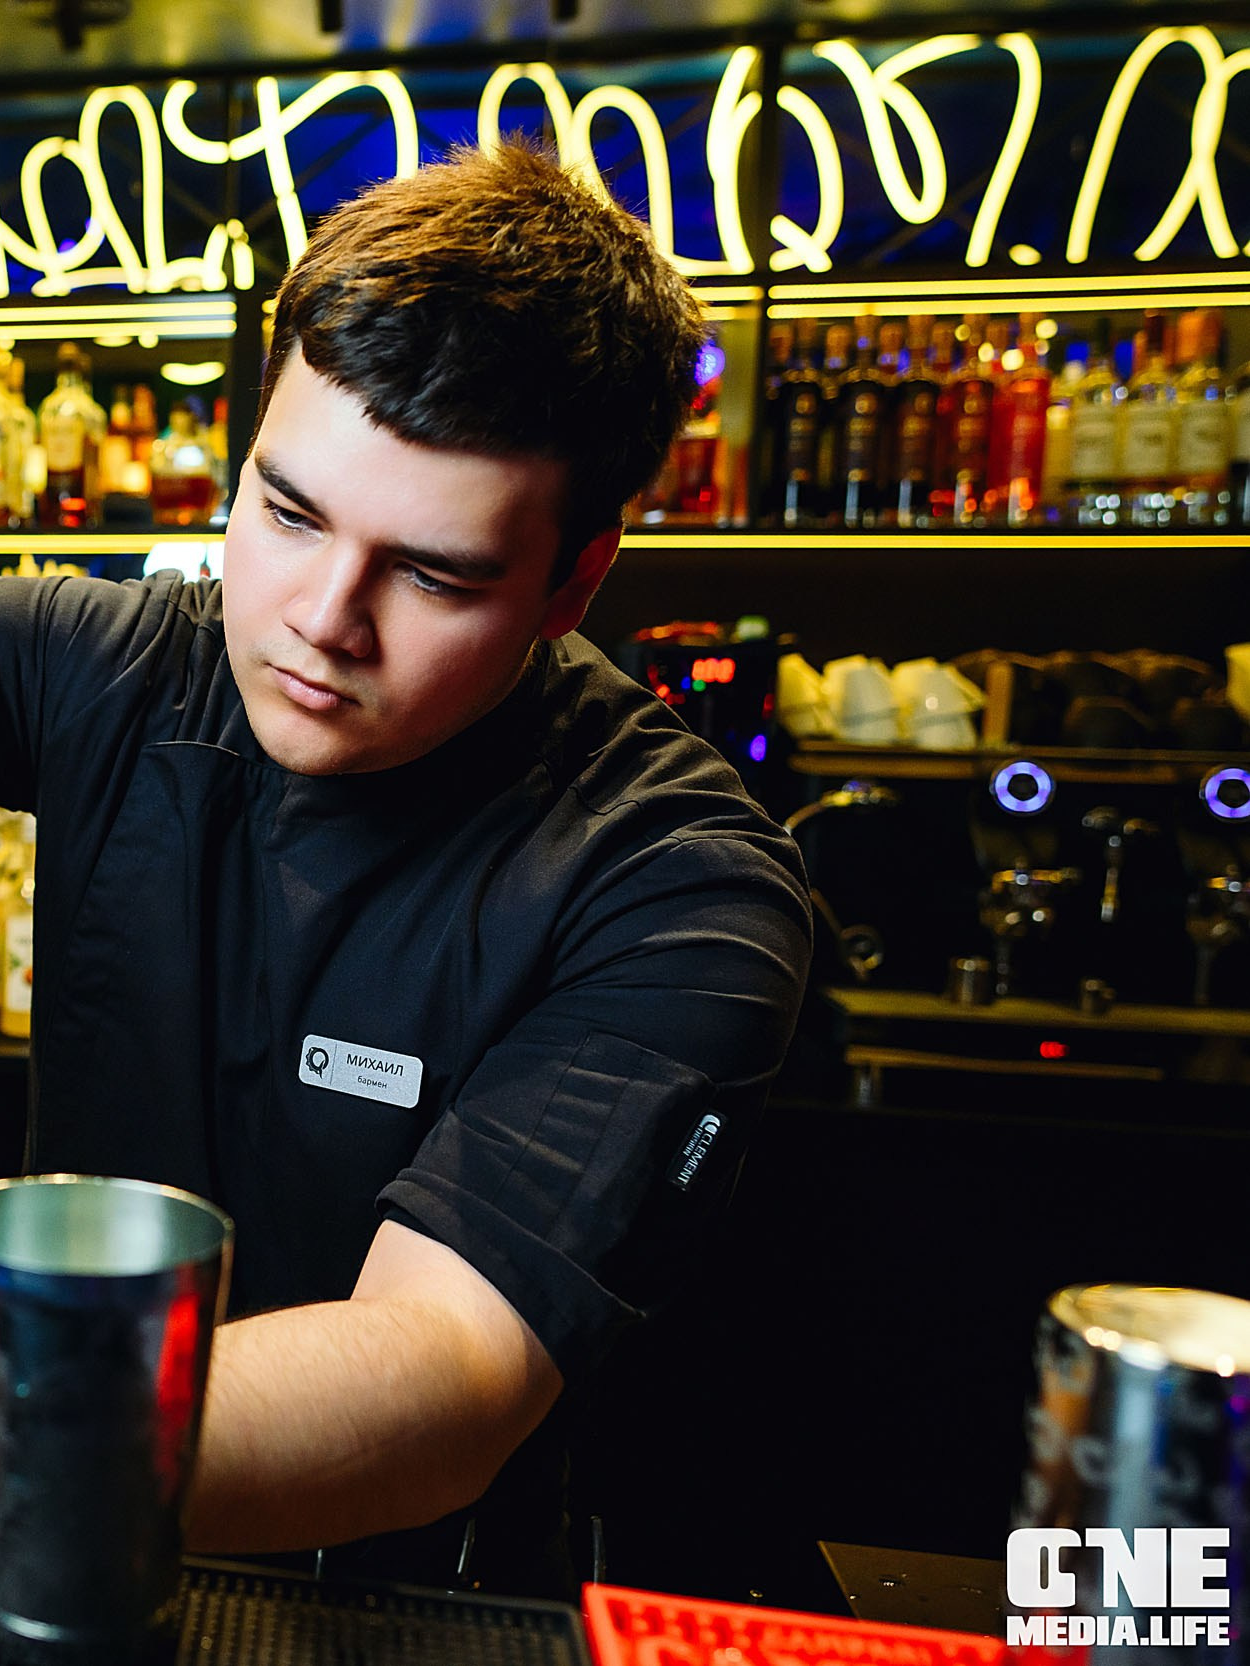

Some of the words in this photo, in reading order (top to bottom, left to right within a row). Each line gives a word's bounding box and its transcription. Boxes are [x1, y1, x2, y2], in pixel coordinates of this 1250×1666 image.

[346, 1053, 404, 1077] МИХАИЛ
[357, 1075, 388, 1089] бармен
[677, 1133, 714, 1186] CLEMENT
